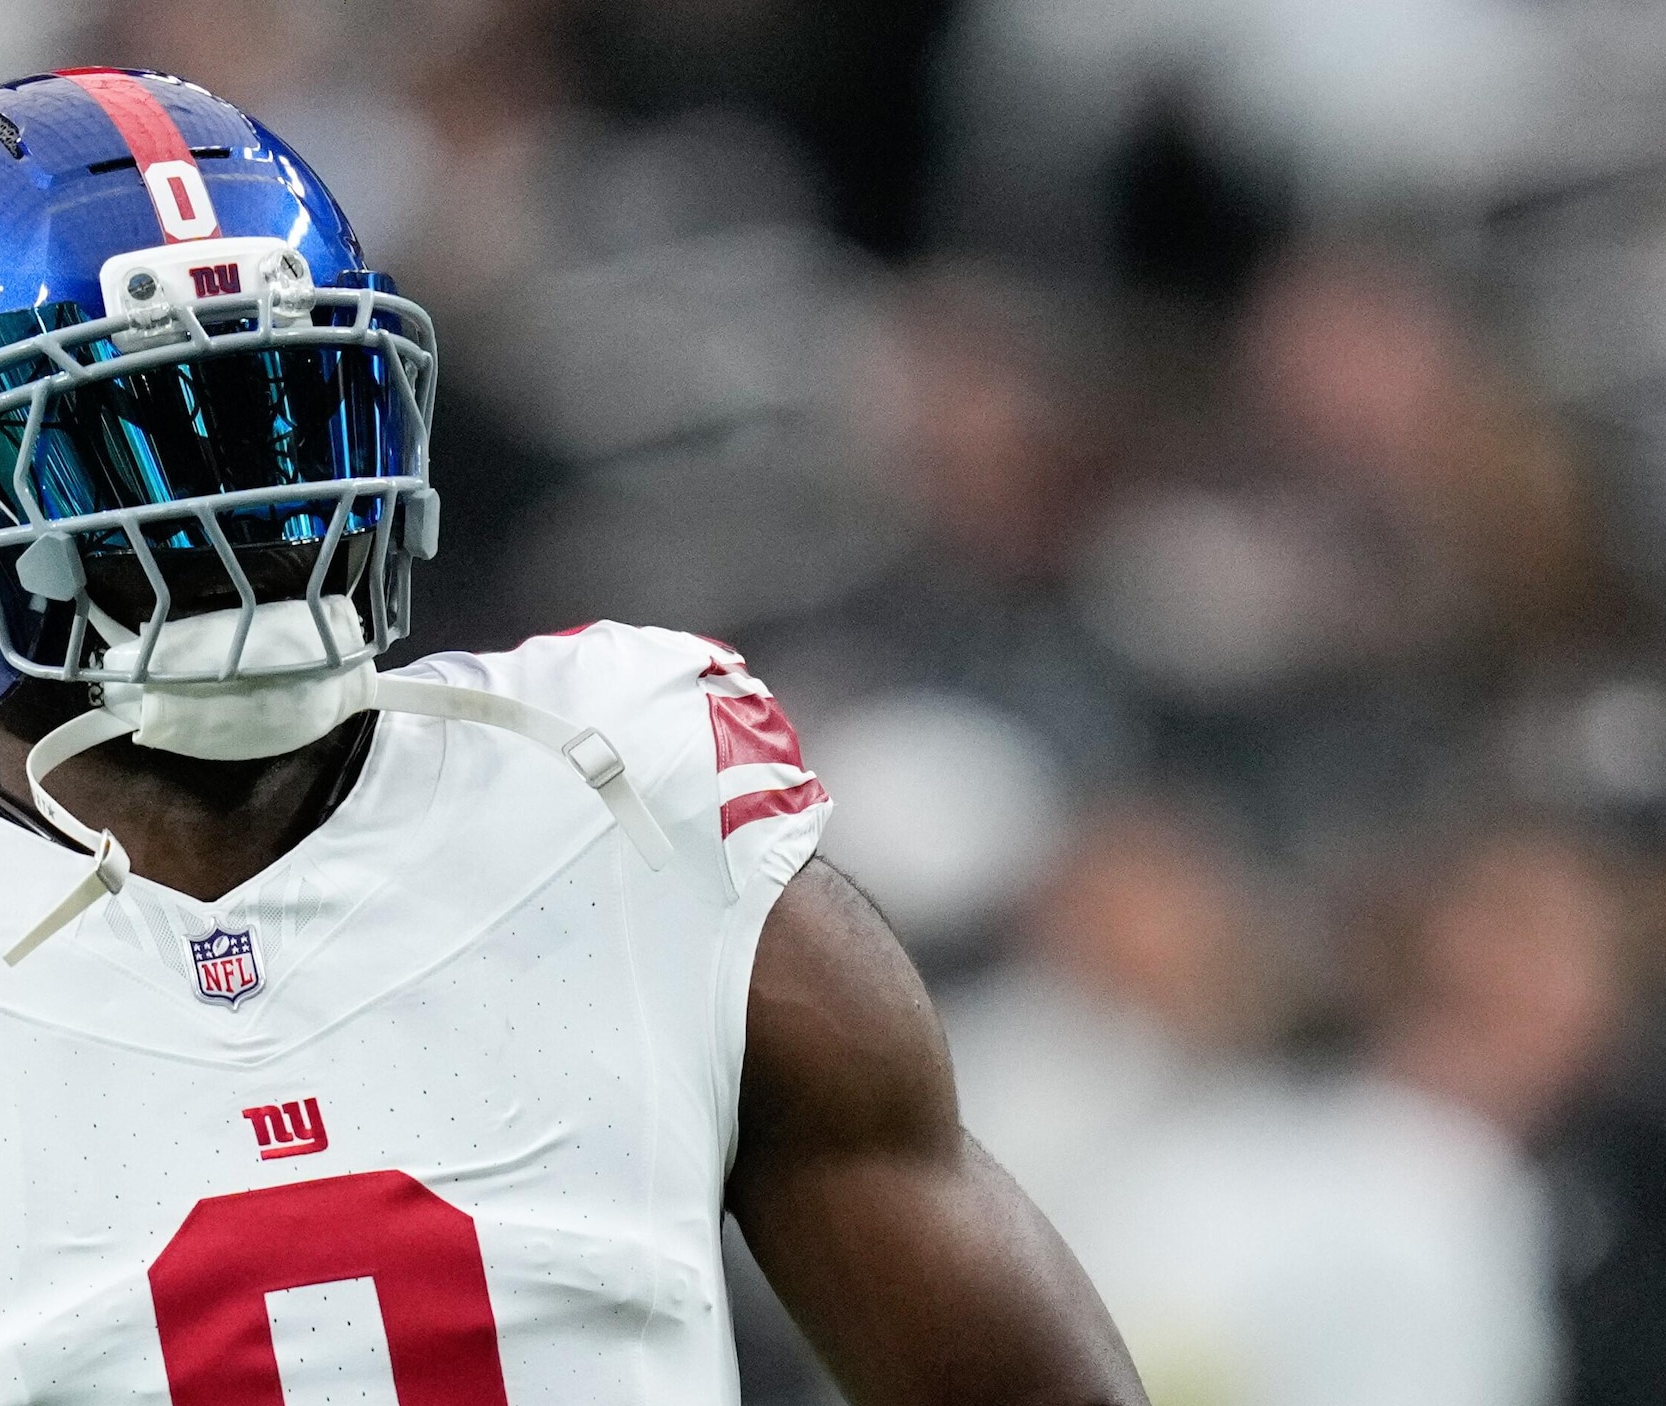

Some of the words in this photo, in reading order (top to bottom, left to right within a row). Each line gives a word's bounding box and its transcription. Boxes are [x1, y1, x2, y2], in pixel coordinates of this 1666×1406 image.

[144, 159, 218, 240] 0
[201, 957, 253, 993] NFL
[242, 1097, 329, 1161] ny
